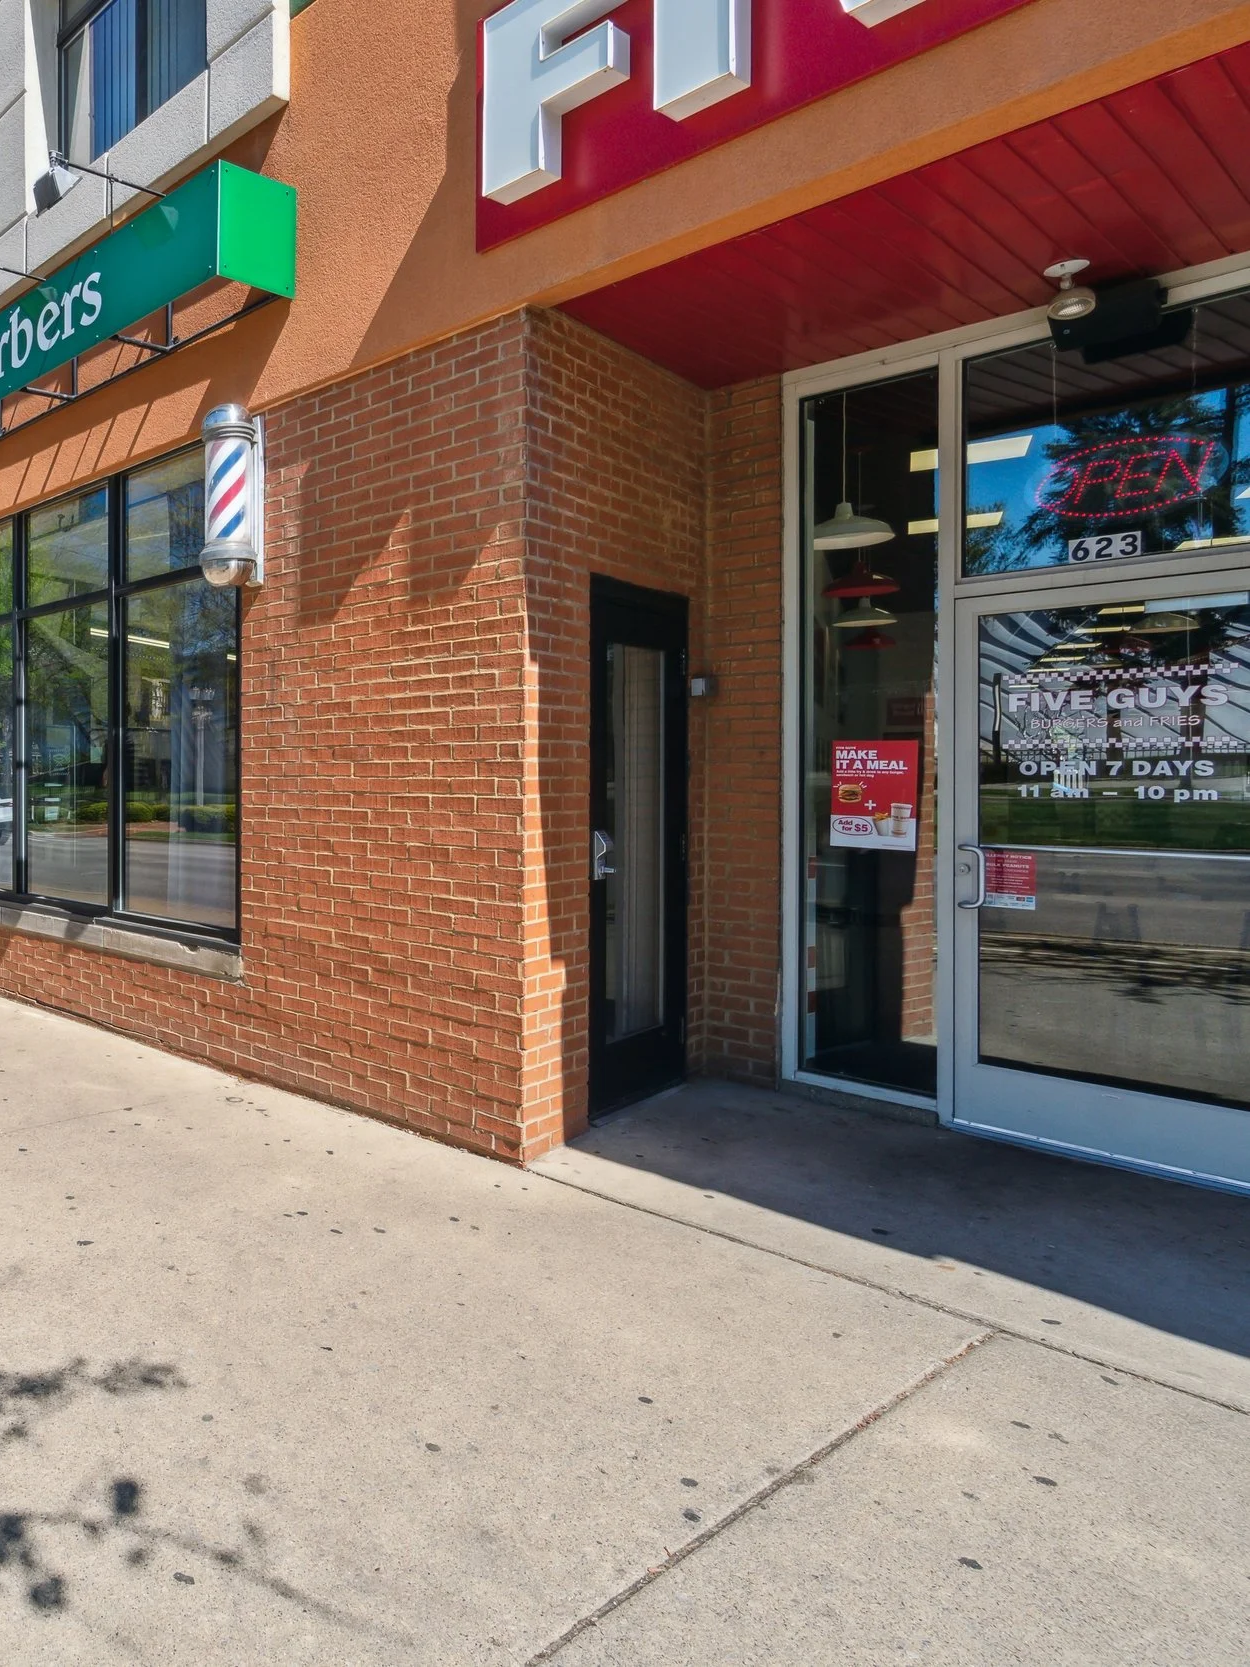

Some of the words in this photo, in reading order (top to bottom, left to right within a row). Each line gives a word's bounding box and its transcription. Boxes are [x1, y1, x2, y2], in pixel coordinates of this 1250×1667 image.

[1035, 438, 1214, 514] OPEN
[1071, 533, 1139, 561] 623
[1008, 690, 1093, 712] FIVE
[1106, 684, 1228, 710] GUYS
[1031, 717, 1108, 729] BURGERS
[1112, 716, 1143, 728] and
[1149, 714, 1201, 727] FRIES
[836, 750, 877, 759] MAKE
[836, 760, 849, 769] IT
[853, 760, 863, 769] A
[866, 760, 908, 770] MEAL
[1019, 760, 1097, 776] OPEN
[1105, 761, 1123, 776] 7
[1132, 760, 1214, 776] DAYS
[1017, 785, 1040, 798] 11
[1050, 786, 1089, 799] am
[1134, 785, 1165, 799] 10
[1173, 787, 1219, 802] pm
[854, 823, 869, 832] $5
